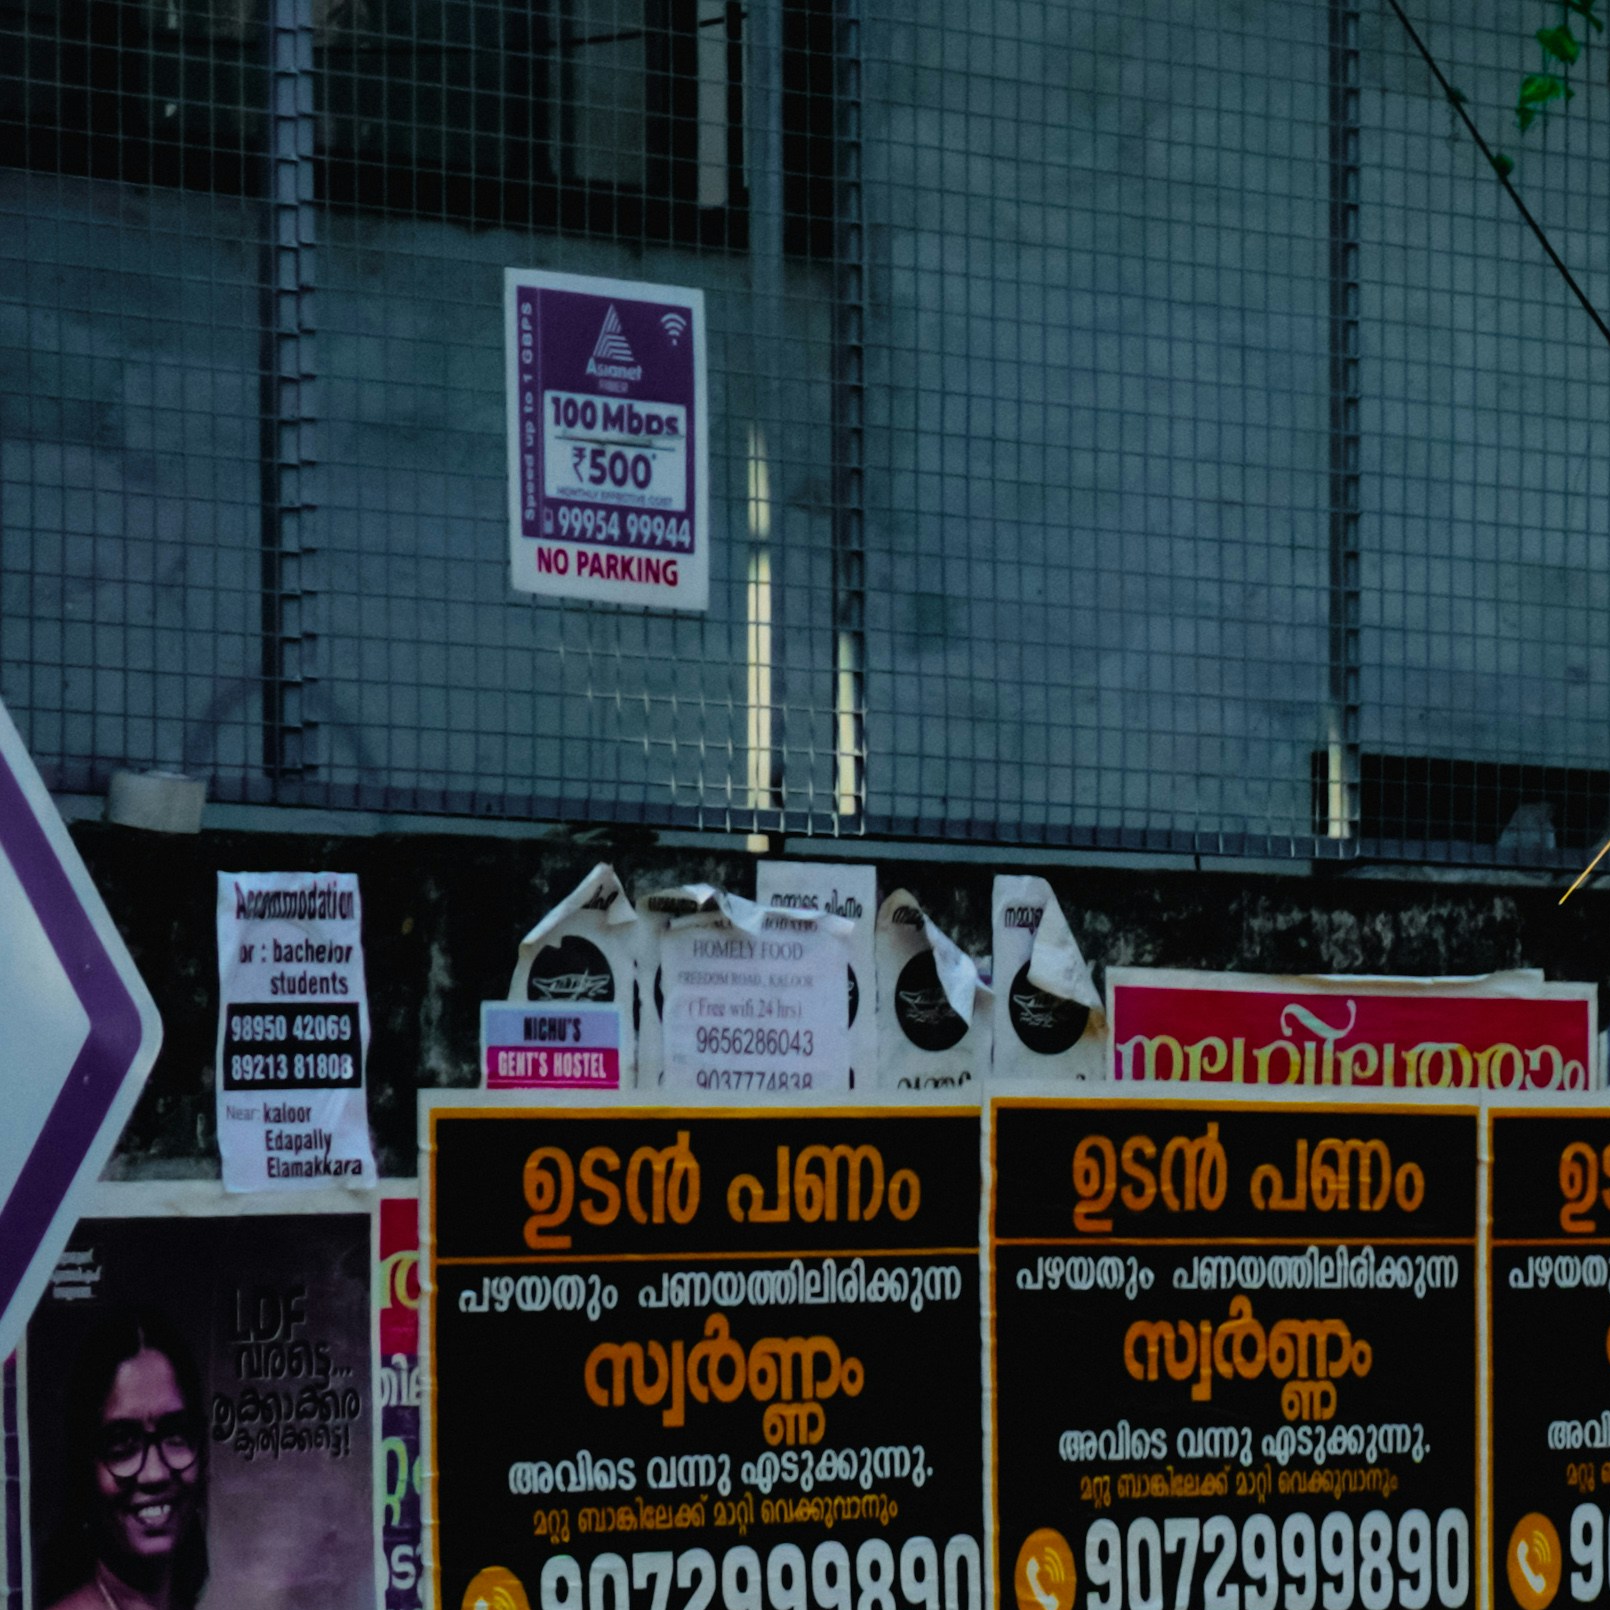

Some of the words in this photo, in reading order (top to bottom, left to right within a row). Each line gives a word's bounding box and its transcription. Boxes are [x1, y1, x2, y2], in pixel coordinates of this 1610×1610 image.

[585, 356, 642, 381] Asianet
[551, 396, 597, 430] 100
[602, 402, 680, 436] Mbps
[558, 506, 621, 543] 99954
[627, 513, 691, 549] 99944
[537, 548, 569, 576] NO
[577, 550, 678, 588] PARKING
[234, 881, 355, 920] Accommodation
[272, 938, 353, 967] bachelor
[693, 939, 754, 960] HOMELY
[760, 940, 804, 961] FOOD
[270, 971, 348, 996] students
[231, 1015, 287, 1042] 98950
[292, 1014, 351, 1041] 42069
[757, 1000, 774, 1018] 24
[524, 1016, 581, 1042] NICHU'S
[697, 1026, 815, 1057] 9656286043
[231, 1054, 288, 1081] 89213
[293, 1053, 353, 1081] 81808
[498, 1050, 549, 1078] GENT'S
[553, 1051, 606, 1079] HOSTEL
[262, 1102, 312, 1124] kaloor
[265, 1128, 332, 1158] Edapally
[267, 1155, 363, 1179] Elamakkara
[1072, 1122, 1228, 1233] ഉടൻ
[1250, 1138, 1425, 1212] പണം
[522, 1129, 701, 1250] ഉടൻ
[726, 1143, 921, 1224] പണം
[458, 1274, 619, 1321] പഴയതും
[638, 1257, 963, 1312] പണയത്തിലിരിക്കുന്ന
[1016, 1255, 1155, 1300] പഴയതും
[1172, 1245, 1458, 1298] പണയത്തിലിരിക്കുന്ന
[1123, 1294, 1373, 1421] സ്വർണ്ണം
[584, 1312, 865, 1446] സ്വർണ്ണം
[1058, 1419, 1167, 1462] അവിടെ
[1176, 1426, 1253, 1467] വന്നു
[1262, 1422, 1431, 1466] എടുക്കുന്നു.
[508, 1449, 637, 1494] അവിടെ
[647, 1453, 732, 1496] വന്നു
[740, 1444, 934, 1494] എടുക്കുന്നു.
[1117, 1464, 1232, 1501] ബാങ്കിലേക്ക്
[1236, 1463, 1273, 1503] മാറ്റി
[578, 1494, 710, 1535] ബാങ്കിലേക്ക്
[713, 1493, 755, 1536] മാറ്റി
[760, 1492, 899, 1530] വെക്കുവാനും
